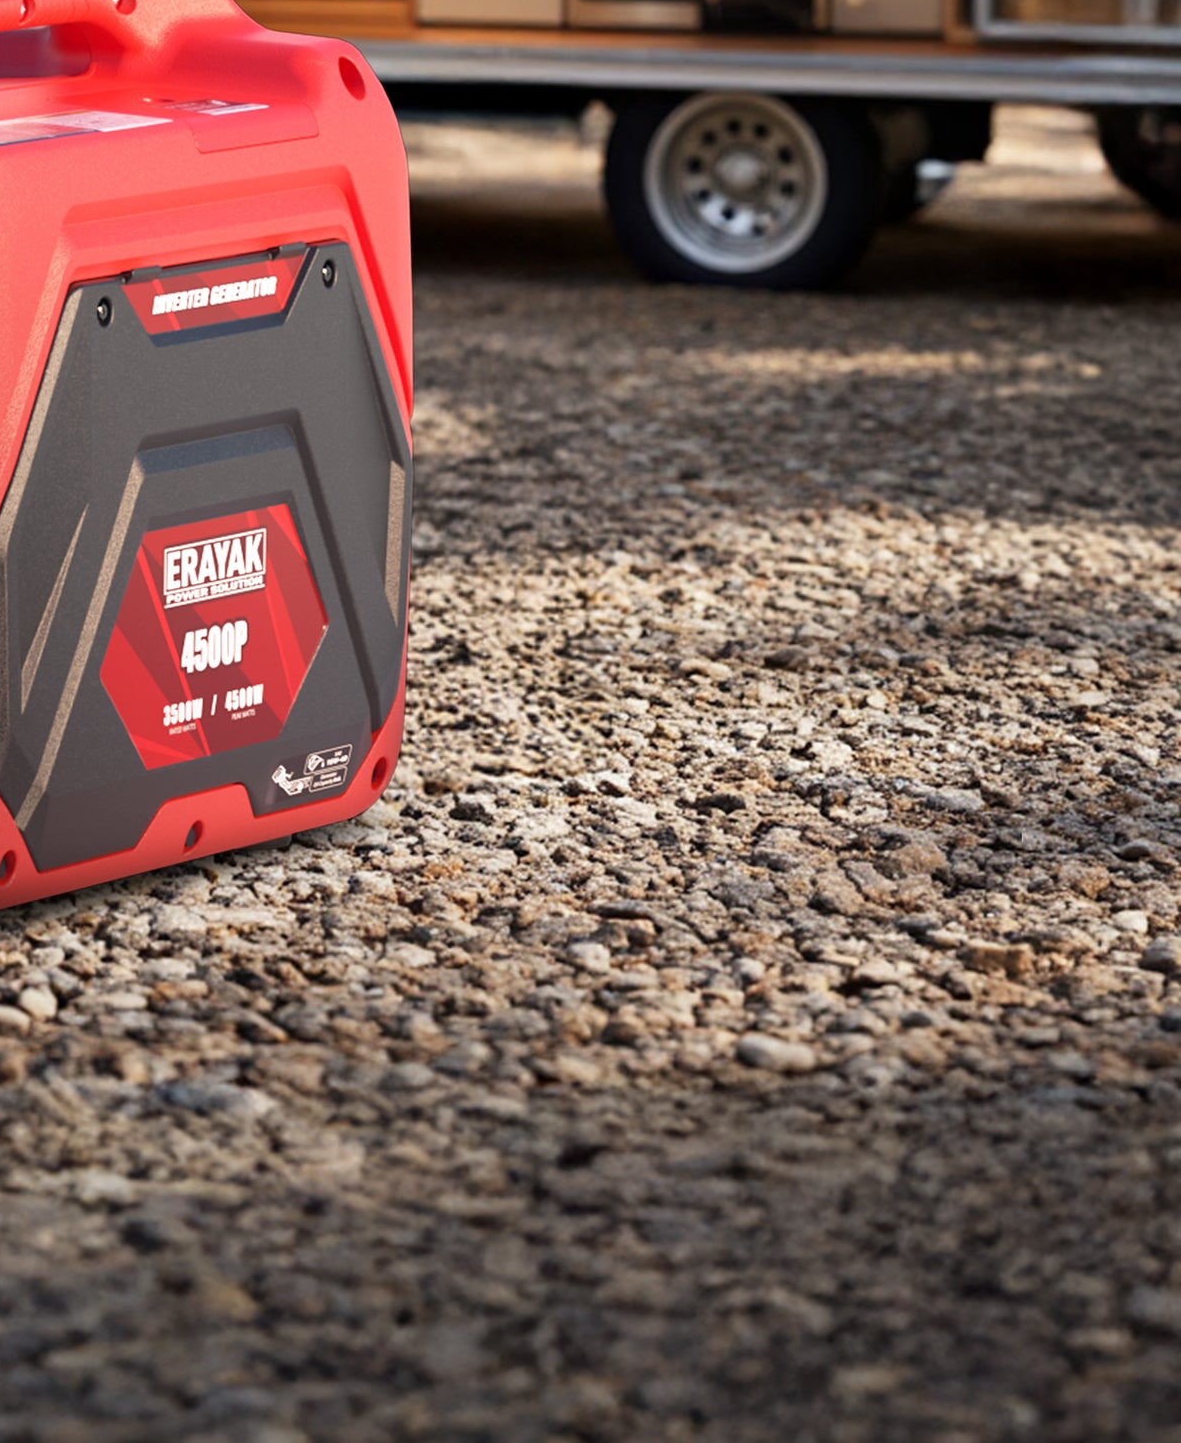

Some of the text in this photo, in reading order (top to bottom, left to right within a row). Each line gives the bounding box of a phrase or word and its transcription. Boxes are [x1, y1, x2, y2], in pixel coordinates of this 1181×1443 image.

[152, 276, 277, 315] INVERTER GENERATOR
[166, 532, 264, 591] ERAYAK
[166, 574, 264, 605] POWER SOLUTION
[180, 620, 248, 674] 4500P
[163, 697, 203, 727] 3500W
[224, 683, 264, 712] 4500W
